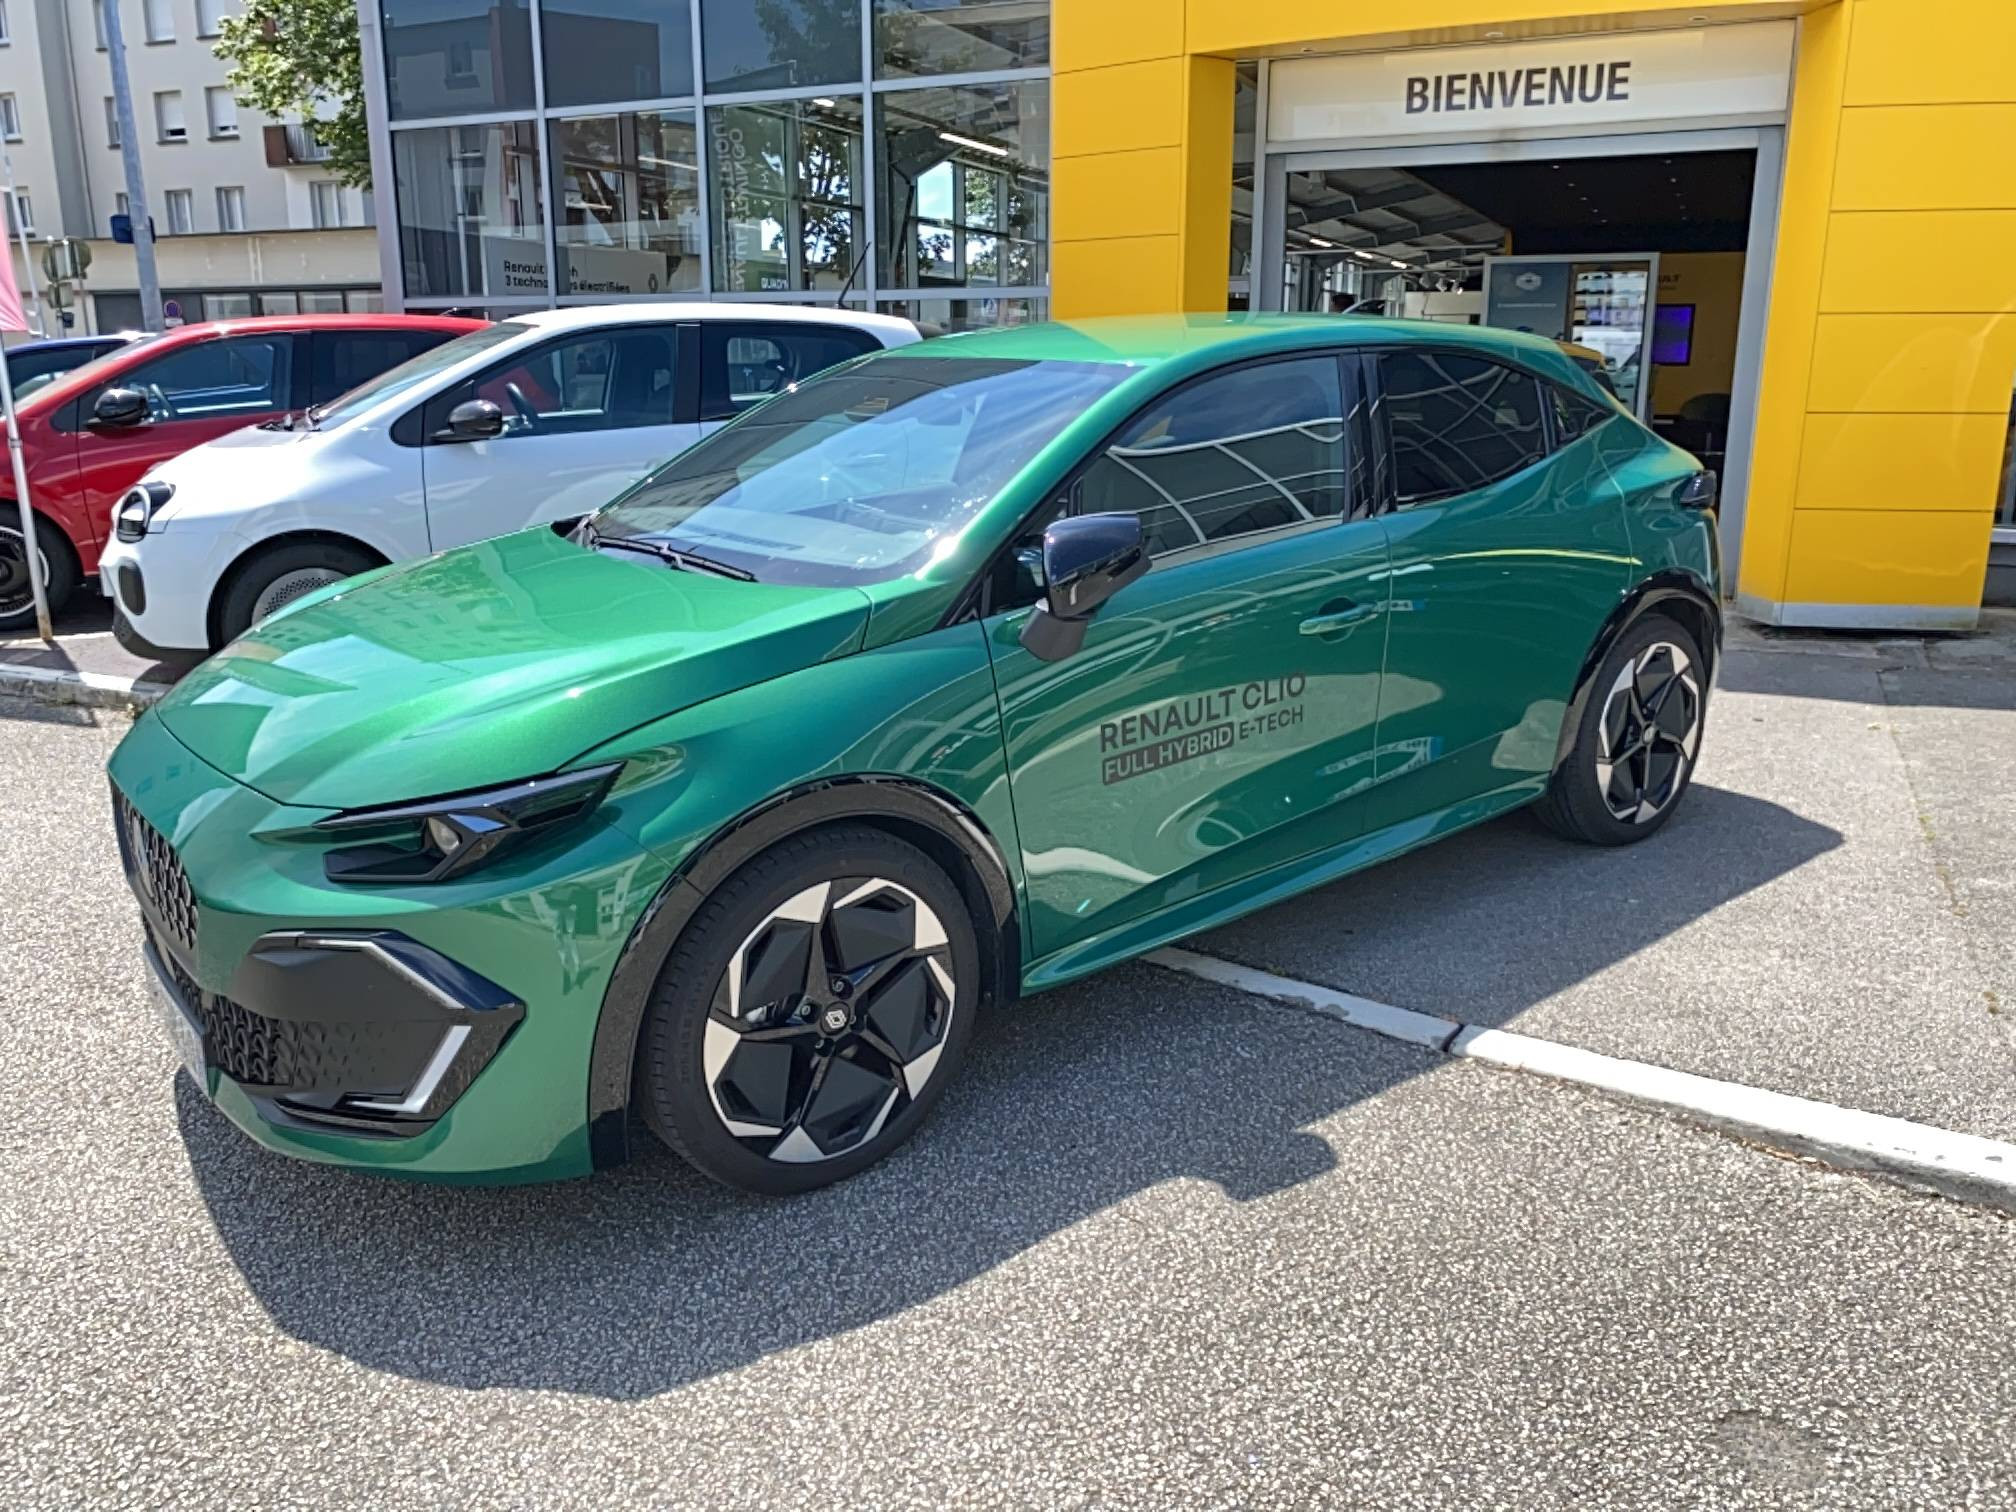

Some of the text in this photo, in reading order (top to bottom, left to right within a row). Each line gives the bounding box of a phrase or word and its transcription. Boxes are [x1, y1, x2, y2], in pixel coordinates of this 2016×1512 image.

[1406, 61, 1631, 113] BIENVENUE
[503, 260, 545, 275] Renault
[1101, 672, 1306, 752] RENAULT CLIO
[1105, 704, 1304, 782] FULL HYBRID E-TECH
